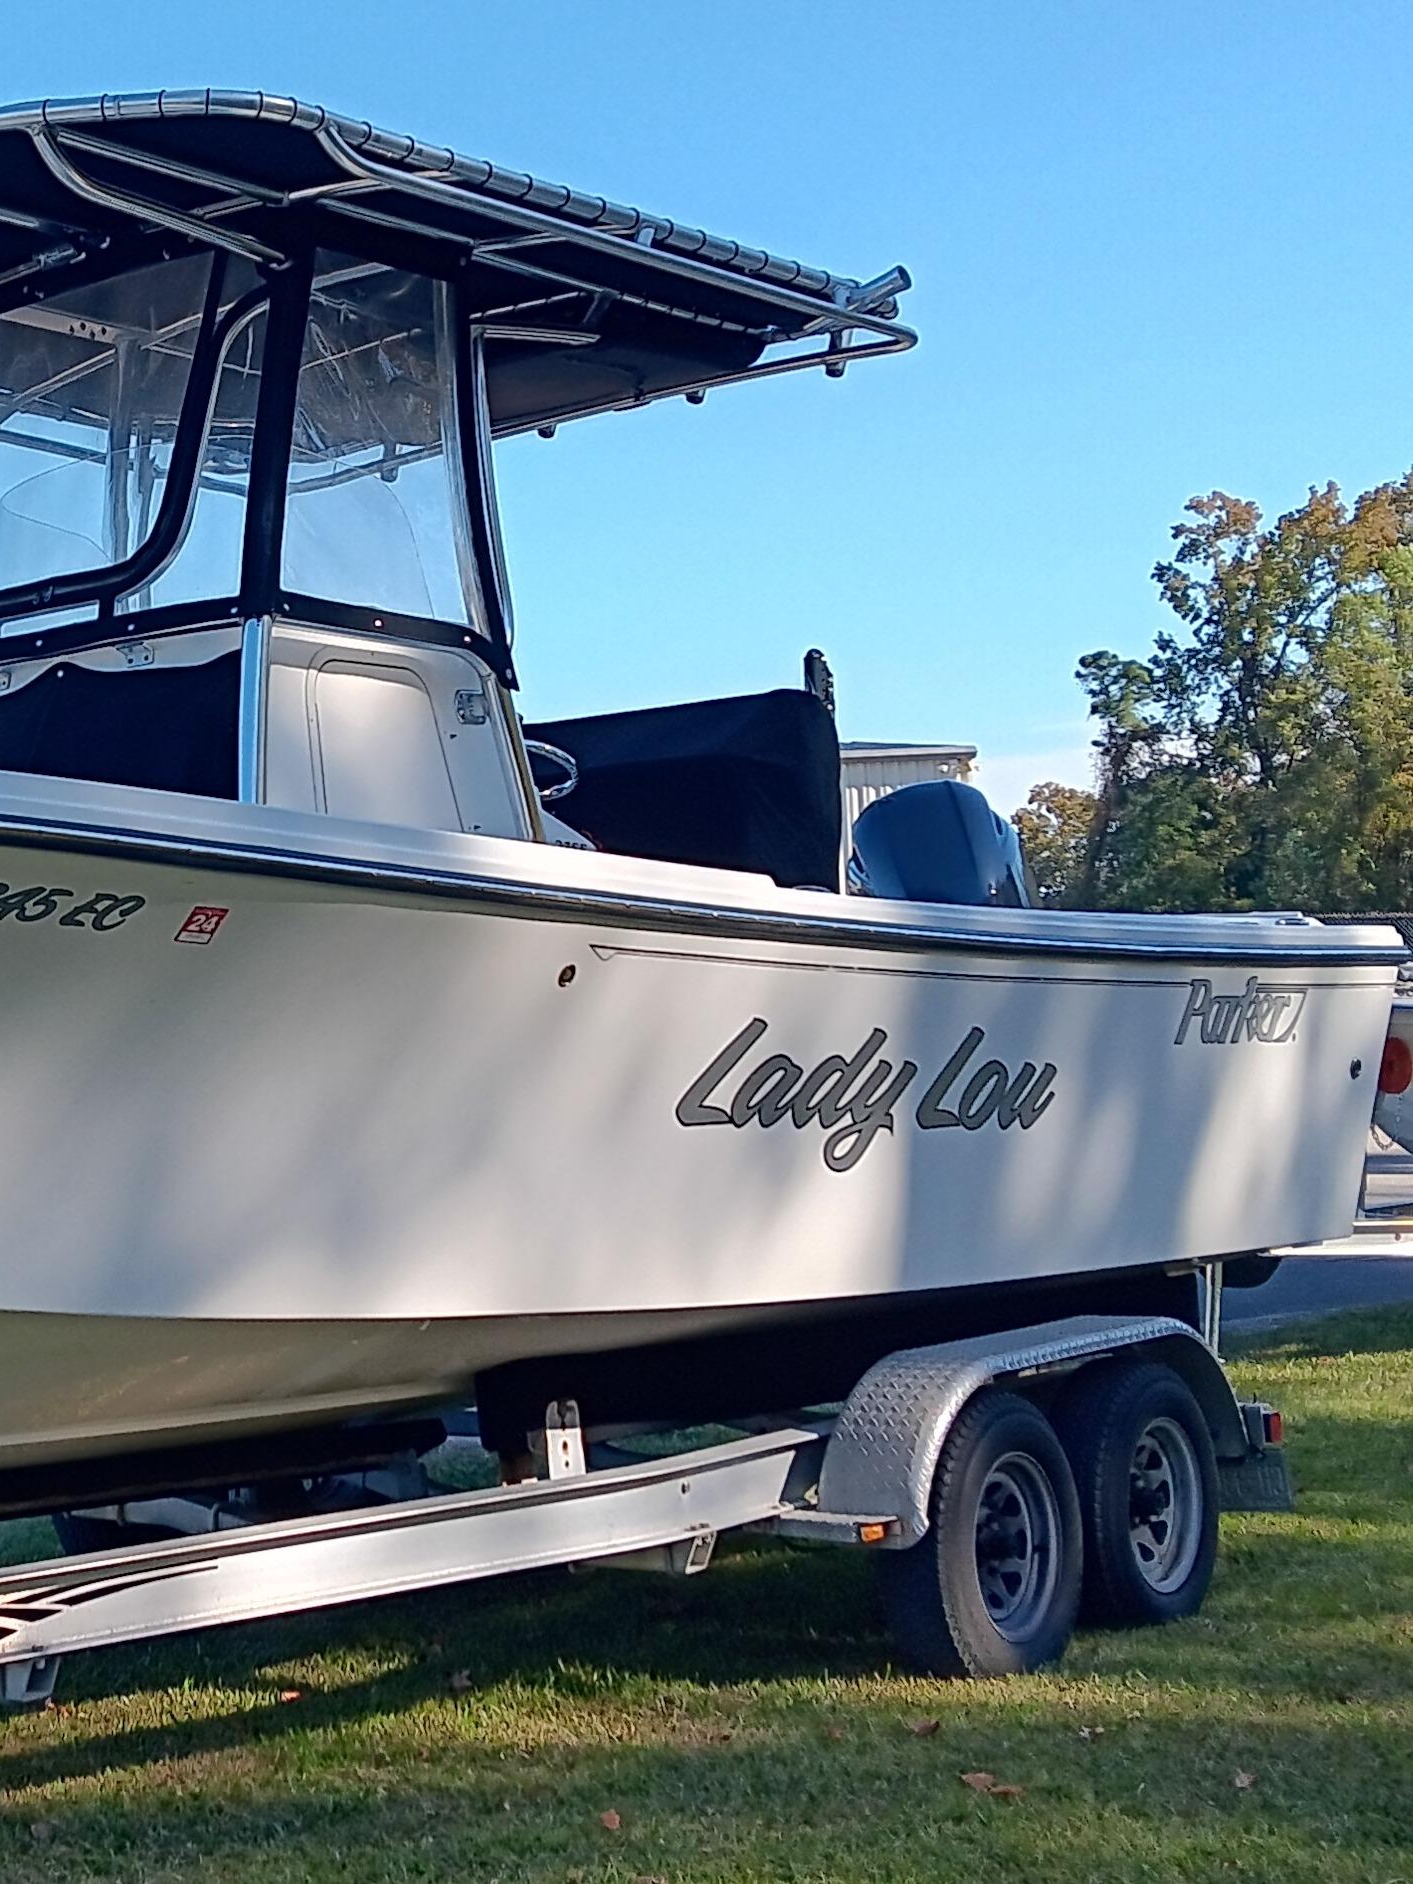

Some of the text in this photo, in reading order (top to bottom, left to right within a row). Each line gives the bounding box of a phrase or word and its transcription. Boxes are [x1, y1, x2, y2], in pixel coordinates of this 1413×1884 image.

[59, 893, 146, 931] EC
[186, 914, 220, 932] 24
[1174, 976, 1309, 1045] Parker
[676, 1017, 1058, 1173] Lady Lou
